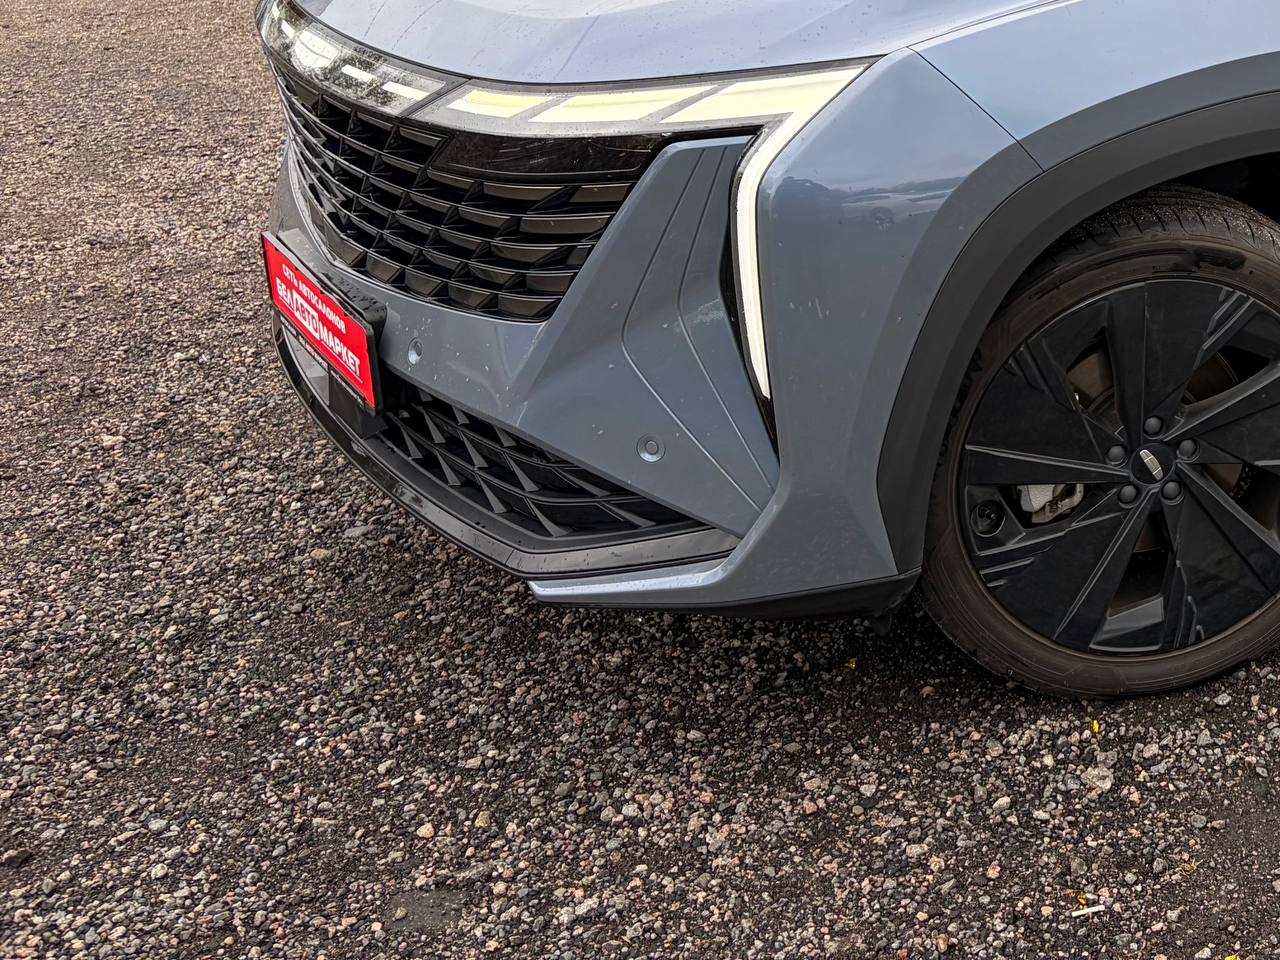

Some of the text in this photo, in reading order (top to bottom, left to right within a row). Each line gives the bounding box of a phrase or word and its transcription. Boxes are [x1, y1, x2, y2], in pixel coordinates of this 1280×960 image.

[276, 277, 294, 310] БЕЛ
[295, 295, 319, 337] АВТО
[319, 321, 361, 377] МАРКЕТ
[282, 263, 299, 288] СЕТЬ
[299, 279, 346, 335] АВТОСАЛОНОВ
